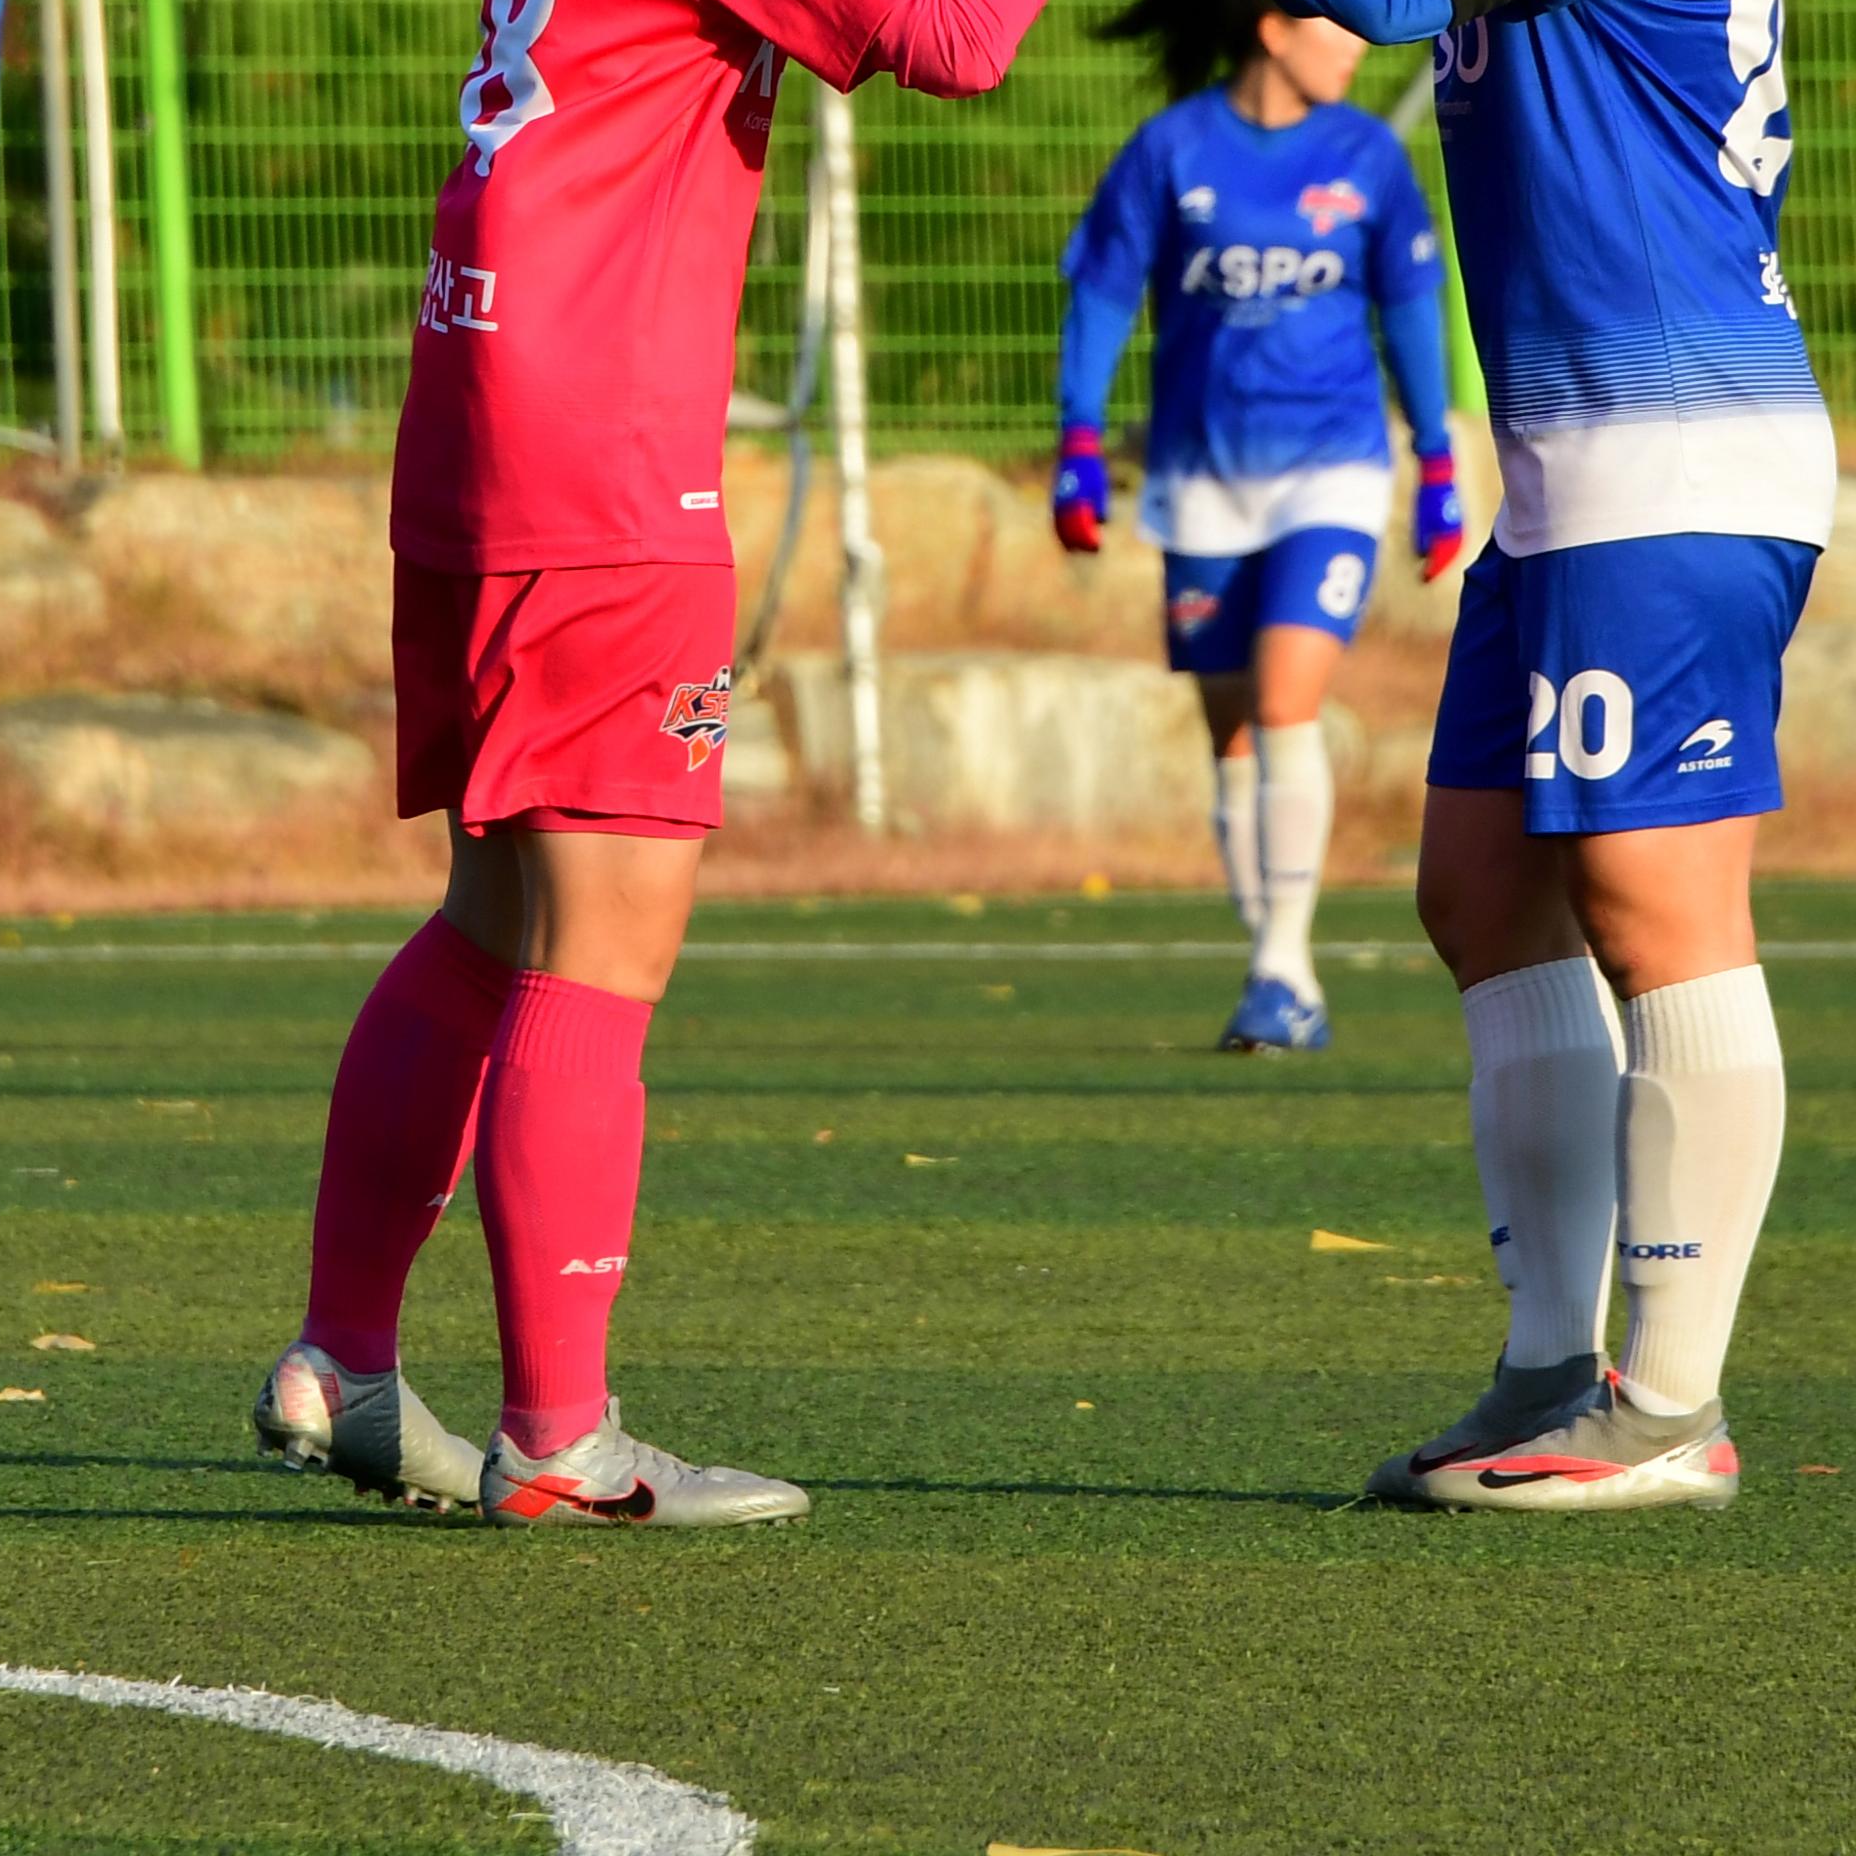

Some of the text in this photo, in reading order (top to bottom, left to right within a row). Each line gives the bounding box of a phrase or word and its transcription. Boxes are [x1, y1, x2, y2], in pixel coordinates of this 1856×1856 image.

[1317, 553, 1366, 619] 8
[1524, 669, 1633, 780] 20
[1677, 755, 1733, 773] ASTORE
